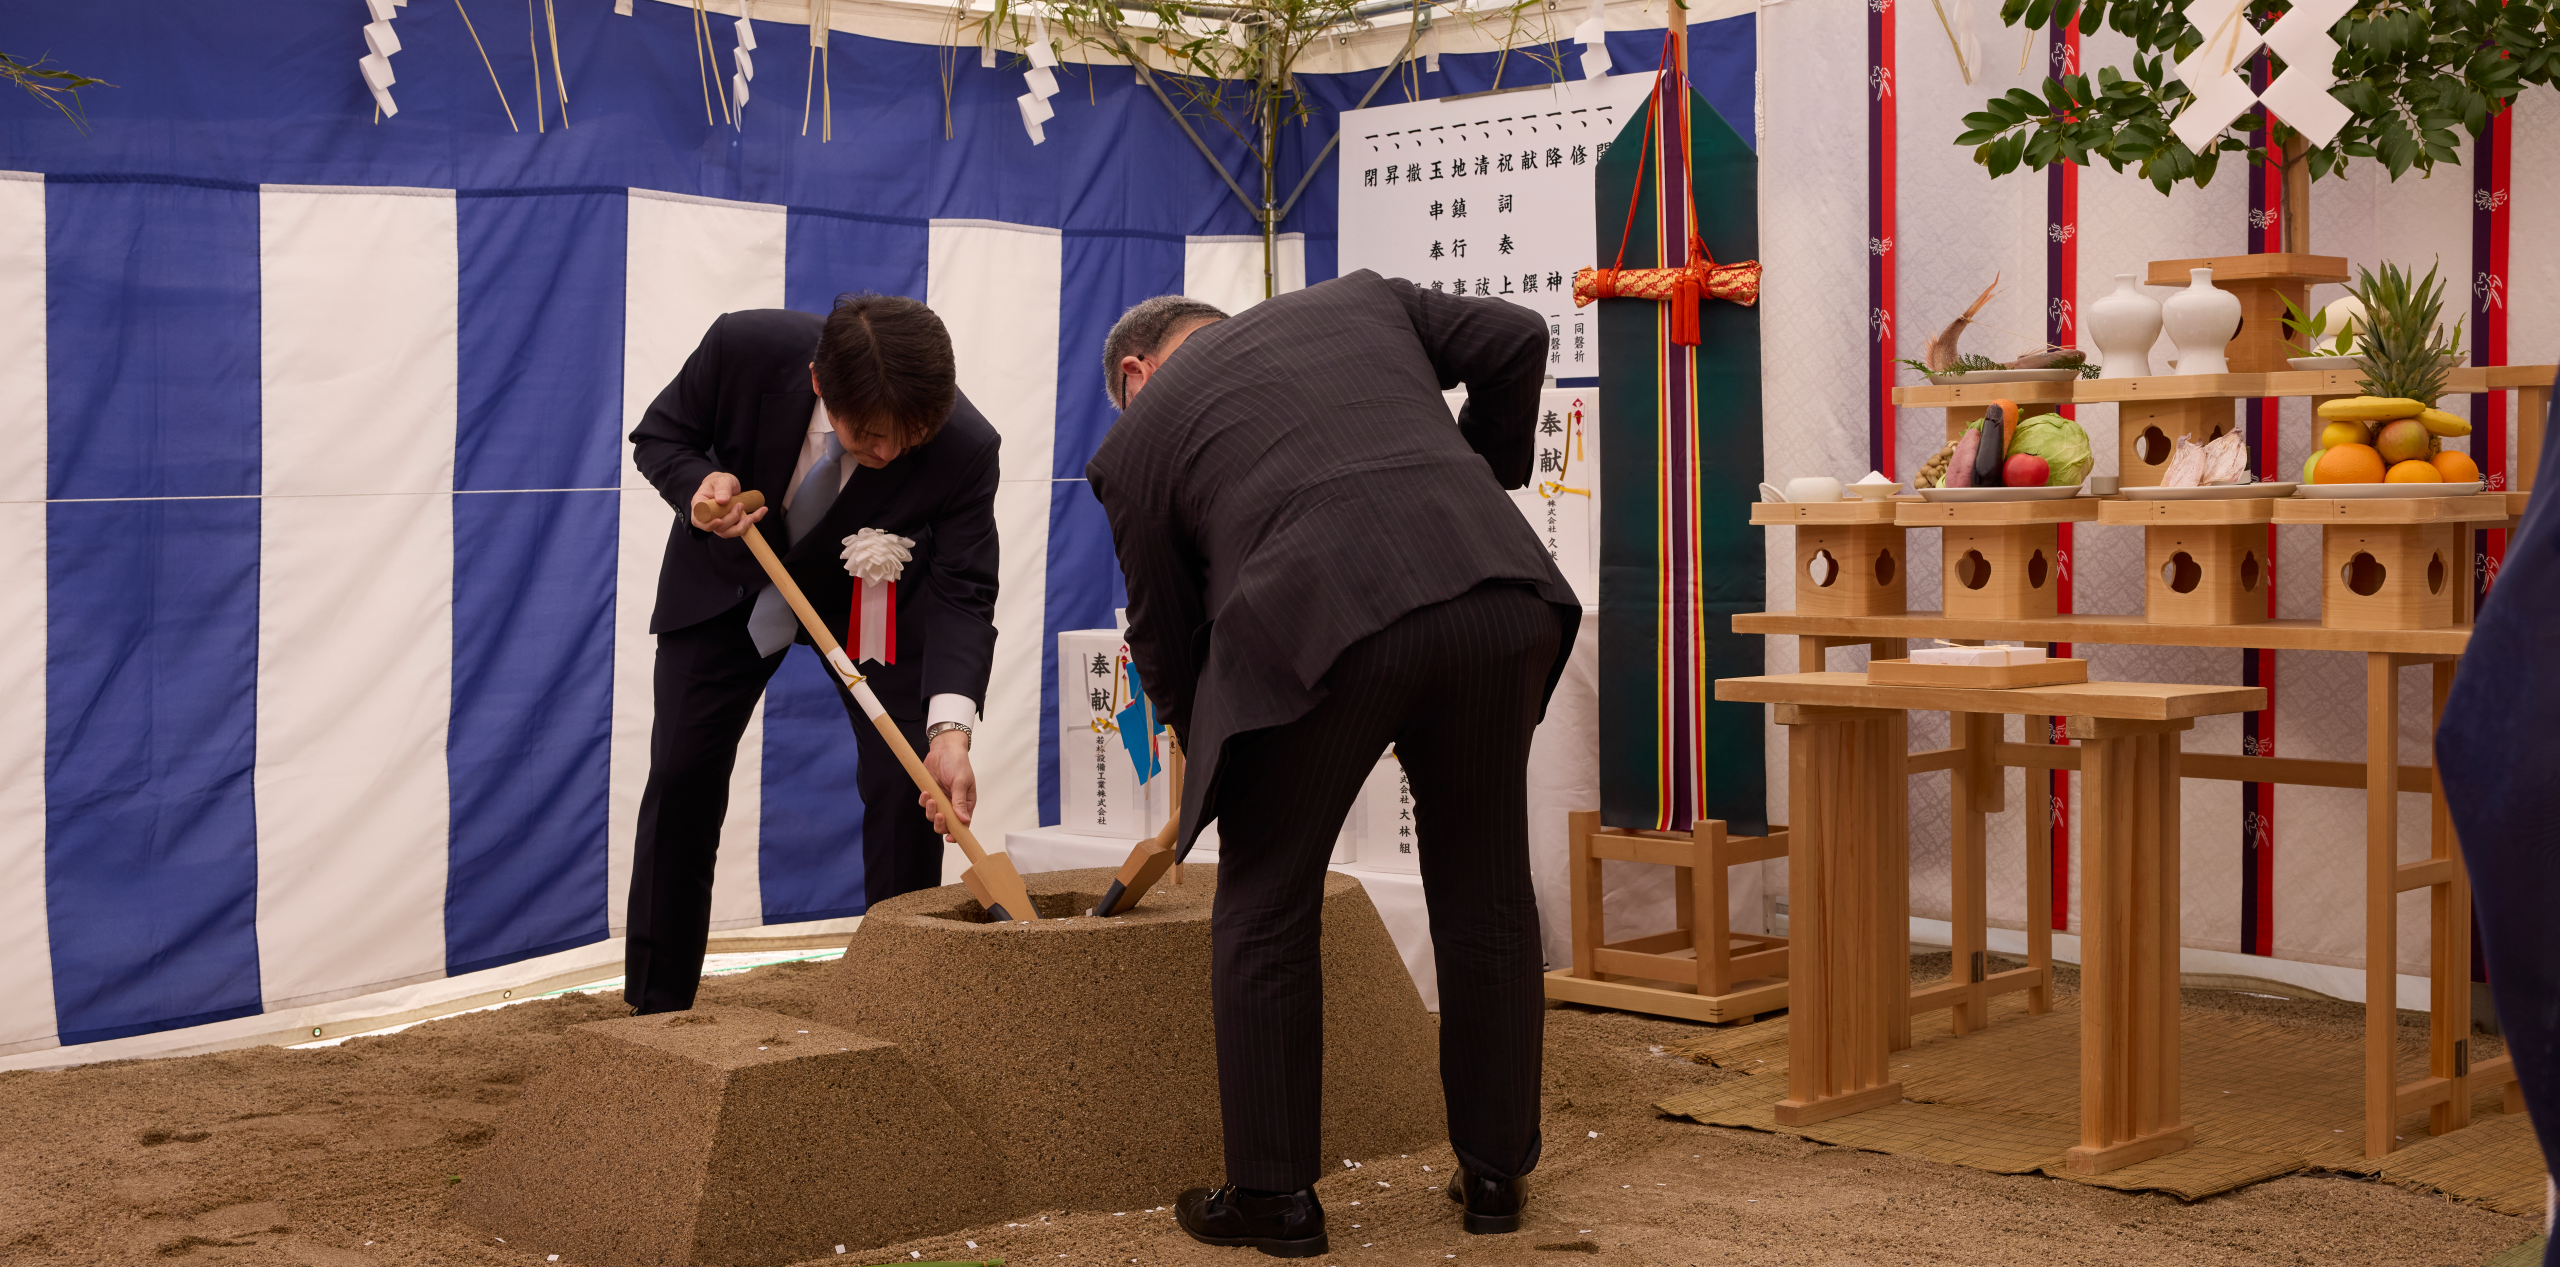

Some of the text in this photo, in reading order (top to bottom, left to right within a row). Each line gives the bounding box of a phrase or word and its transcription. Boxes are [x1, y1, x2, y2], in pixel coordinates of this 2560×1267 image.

[1539, 409, 1564, 474] 奉献
[1546, 499, 1557, 533] 株式会社
[1089, 651, 1113, 712] 奉献
[1399, 808, 1412, 855] 大林組
